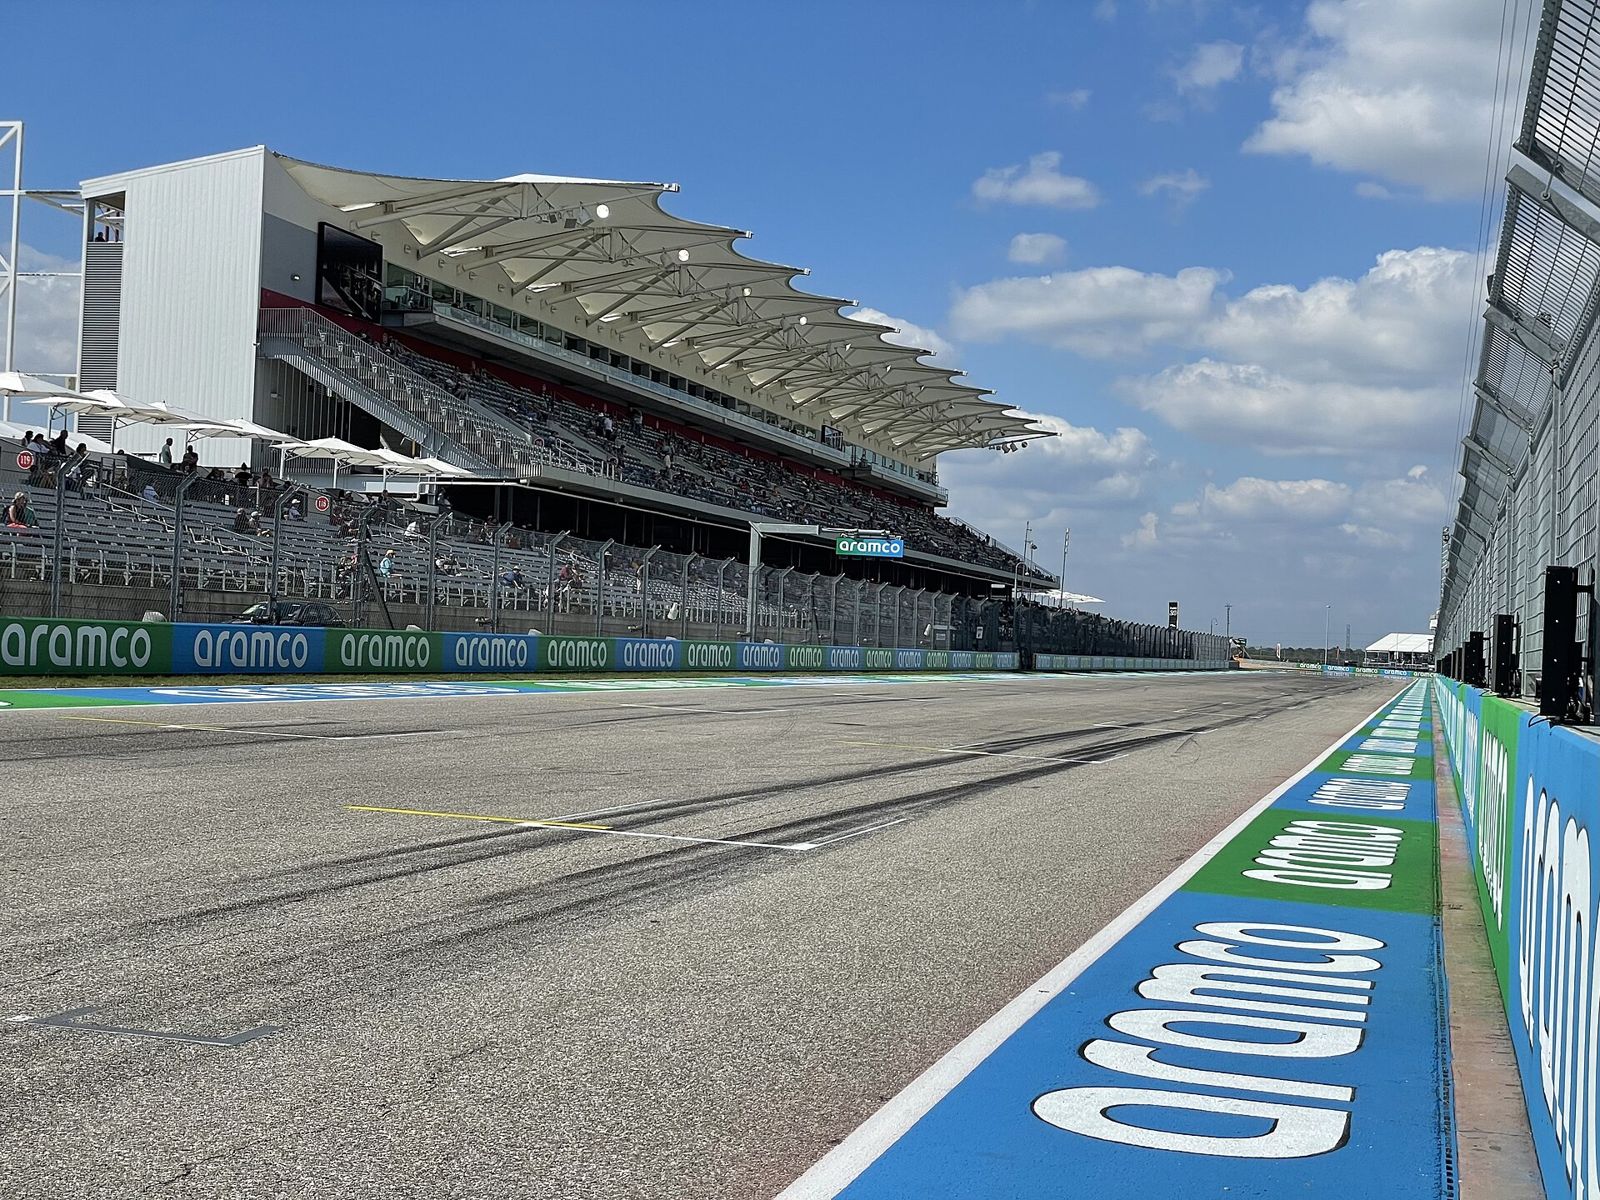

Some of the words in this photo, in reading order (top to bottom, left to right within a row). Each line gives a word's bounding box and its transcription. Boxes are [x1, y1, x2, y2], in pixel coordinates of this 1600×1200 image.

[839, 541, 900, 553] aramco
[2, 623, 151, 667] aramco
[194, 630, 308, 668] aramco
[340, 633, 430, 667] aramco
[455, 636, 527, 667] aramco
[547, 639, 606, 667] aramco
[623, 641, 674, 667] aramco
[687, 643, 731, 667] aramco
[742, 644, 780, 667] aramco
[789, 646, 823, 667] aramco
[831, 648, 859, 667] aramco
[866, 650, 892, 667] aramco
[898, 651, 921, 667] aramco
[926, 652, 948, 667] aramco
[1241, 820, 1403, 890] aramco
[1031, 922, 1387, 1158] aramco
